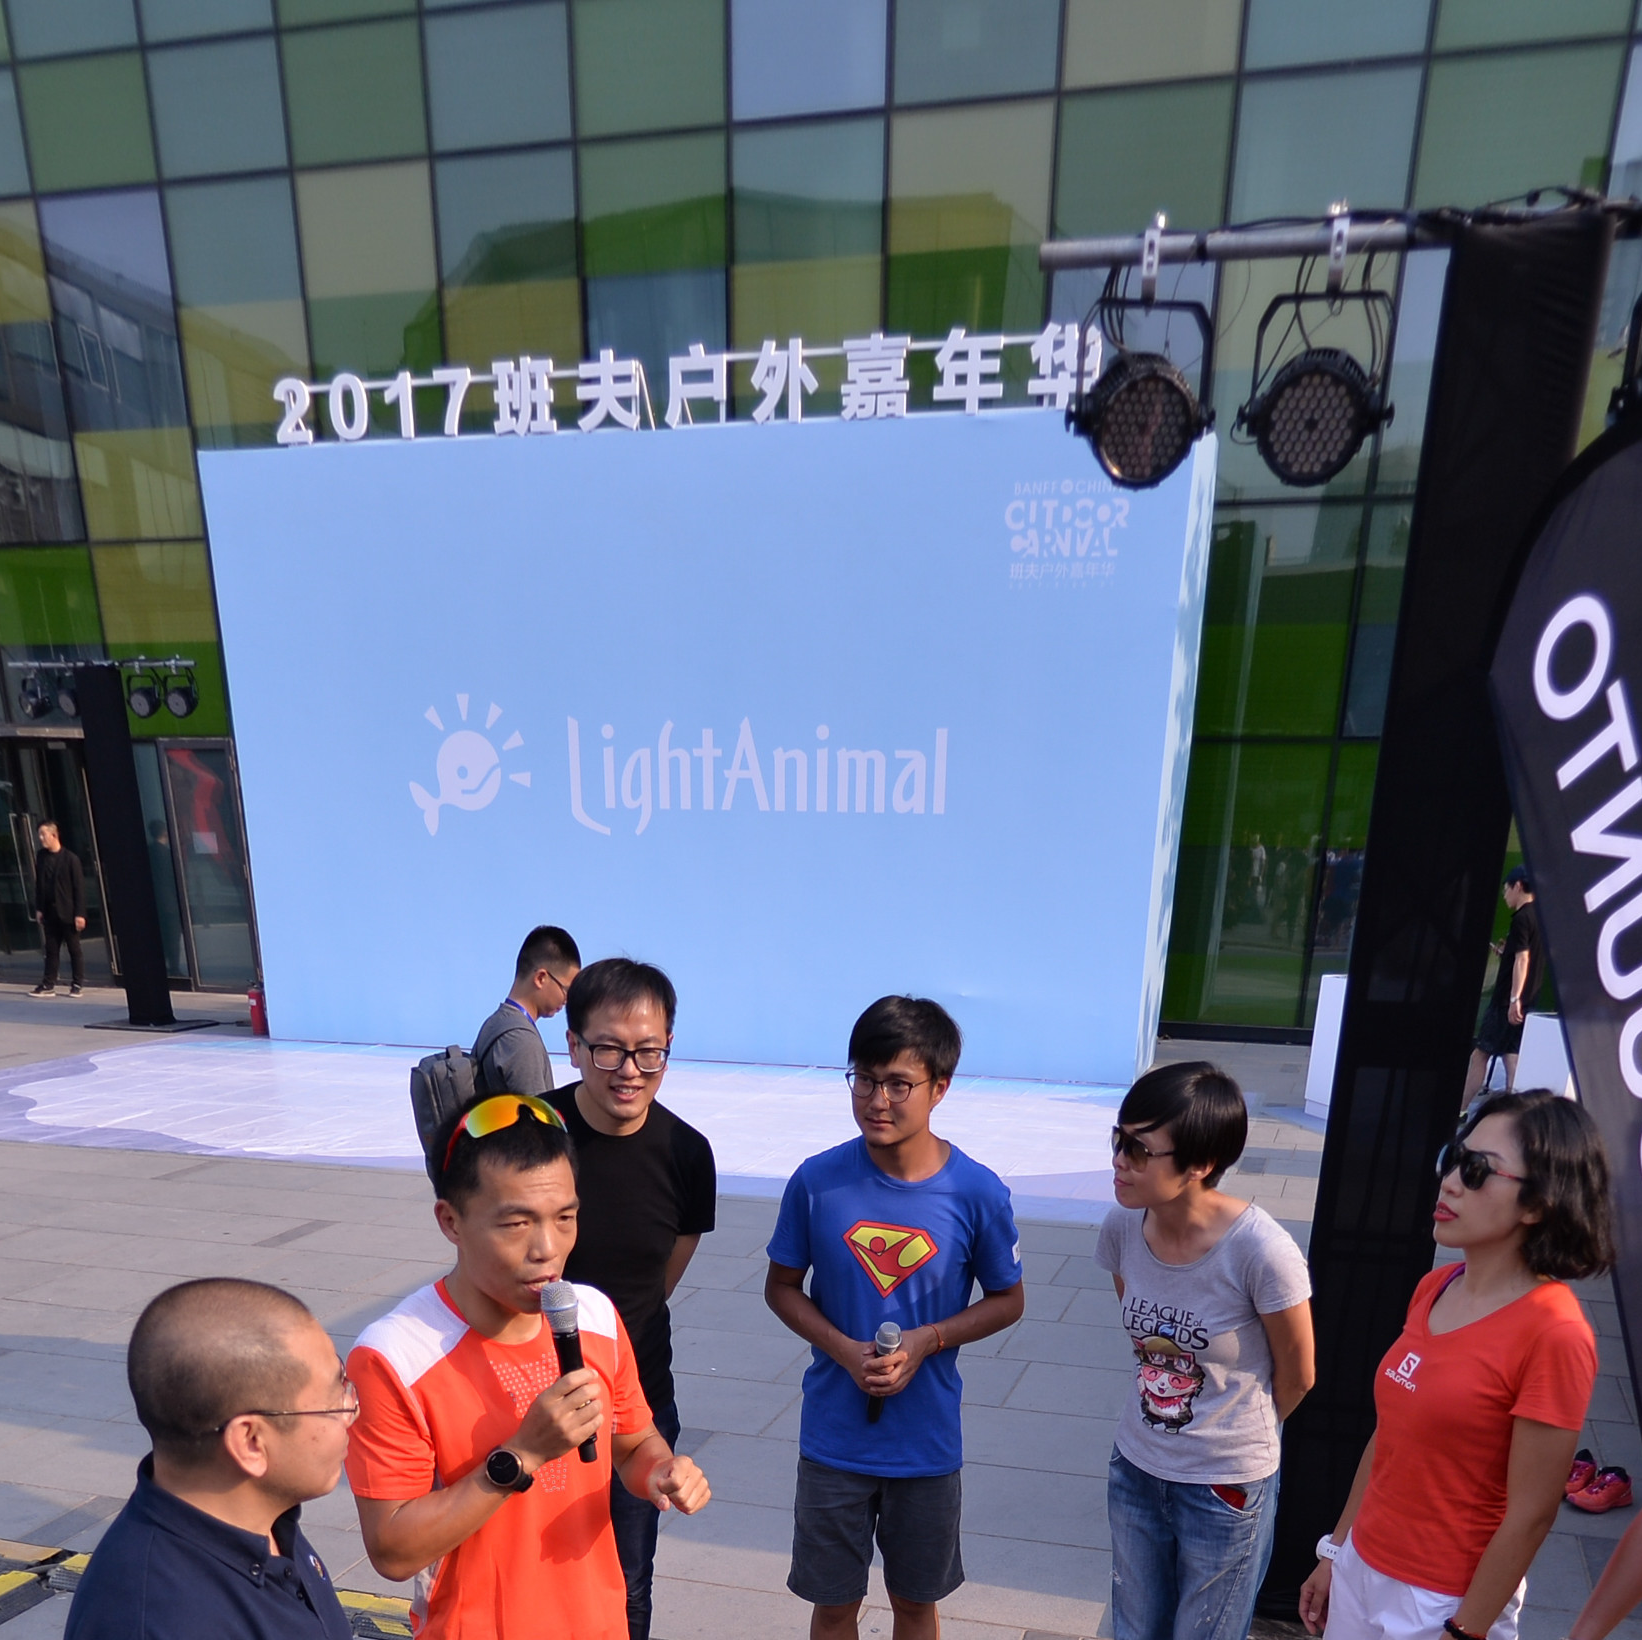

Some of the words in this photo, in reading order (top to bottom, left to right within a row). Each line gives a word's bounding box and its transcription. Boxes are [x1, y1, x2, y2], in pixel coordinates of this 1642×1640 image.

[274, 323, 1103, 446] 2017班夫户外嘉年华
[1013, 480, 1059, 496] BANFF
[1009, 561, 1116, 581] 班夫户外嘉年华
[566, 715, 948, 836] LightAnimal
[1129, 1297, 1194, 1327] LEAGUE
[1193, 1318, 1203, 1327] of
